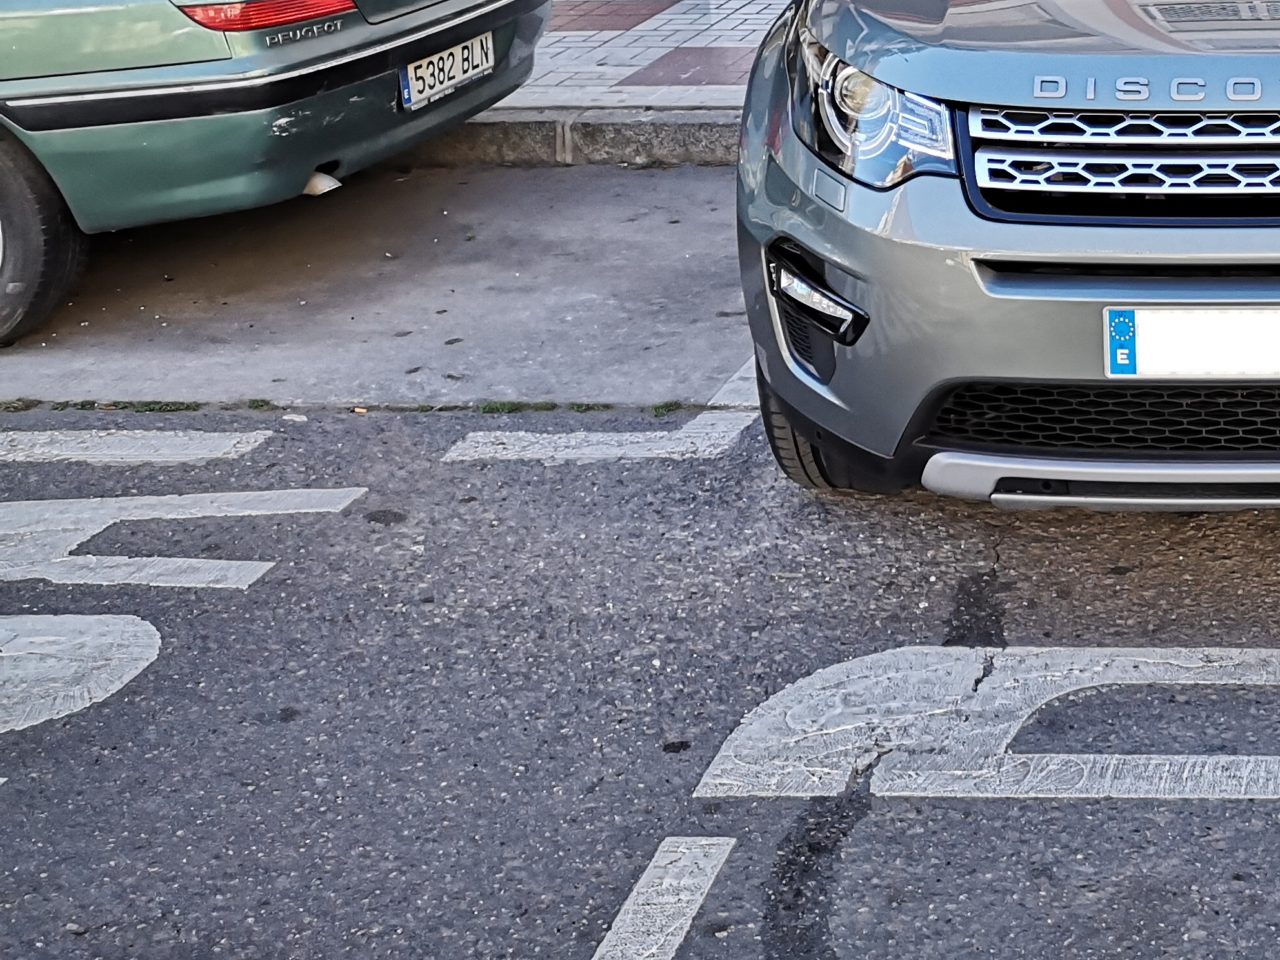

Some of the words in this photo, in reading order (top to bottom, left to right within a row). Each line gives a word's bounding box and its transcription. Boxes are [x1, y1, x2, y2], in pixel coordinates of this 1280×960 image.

[266, 18, 345, 48] PEUGEOT
[413, 51, 456, 95] 5382
[461, 36, 490, 75] BLN
[1116, 349, 1130, 365] E
